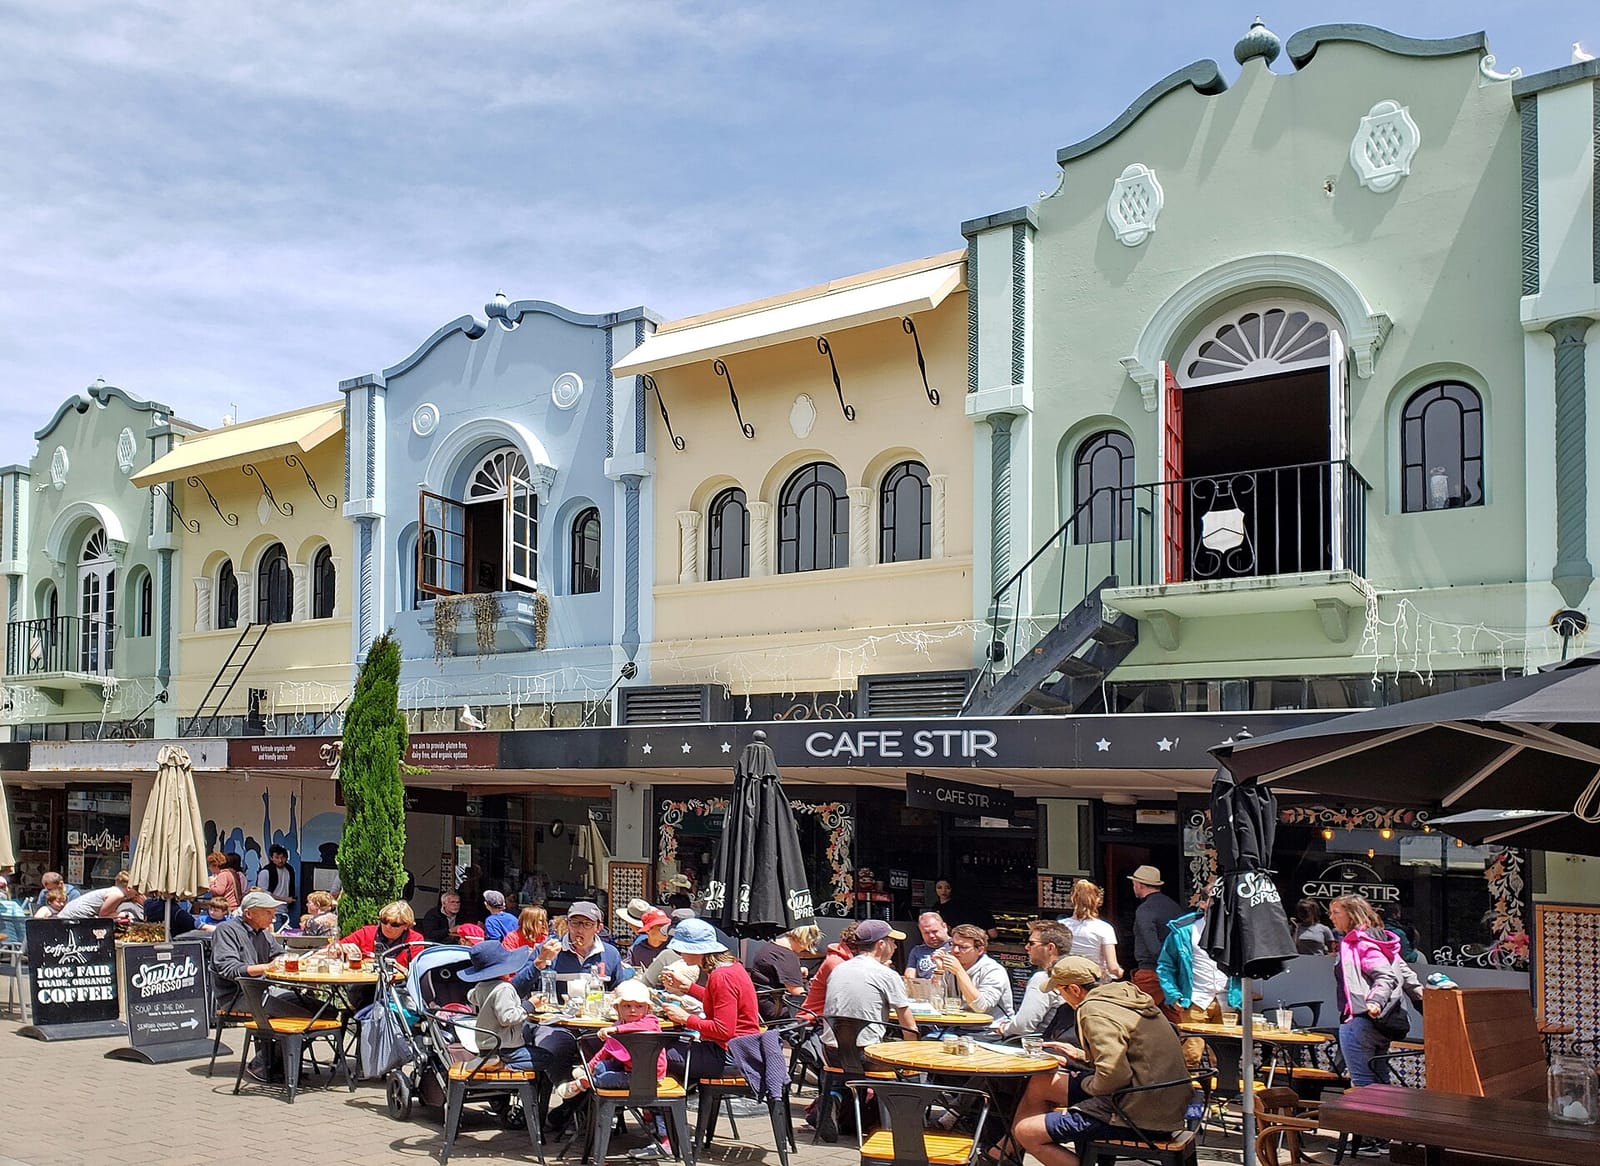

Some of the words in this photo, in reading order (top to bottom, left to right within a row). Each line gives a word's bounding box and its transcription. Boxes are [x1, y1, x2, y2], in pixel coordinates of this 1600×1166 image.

[431, 741, 445, 751] provide
[446, 741, 457, 751] gluten
[805, 731, 904, 758] CAFE
[913, 730, 998, 758] STIR
[411, 751, 421, 760] dairy
[439, 751, 452, 760] organic
[453, 751, 467, 760] options
[936, 788, 966, 806] CAFE
[967, 793, 990, 809] STIR
[890, 876, 908, 887] OPEN
[1302, 883, 1354, 897] CAFE
[1358, 886, 1400, 901] STIR
[37, 966, 74, 979] 100%
[76, 965, 111, 977] FAIR
[132, 956, 198, 988] Switch
[37, 978, 71, 988] TRADE,
[72, 977, 111, 986] ORGANIC
[141, 979, 181, 998] ESPRESSO
[38, 985, 113, 1004] COFFEE
